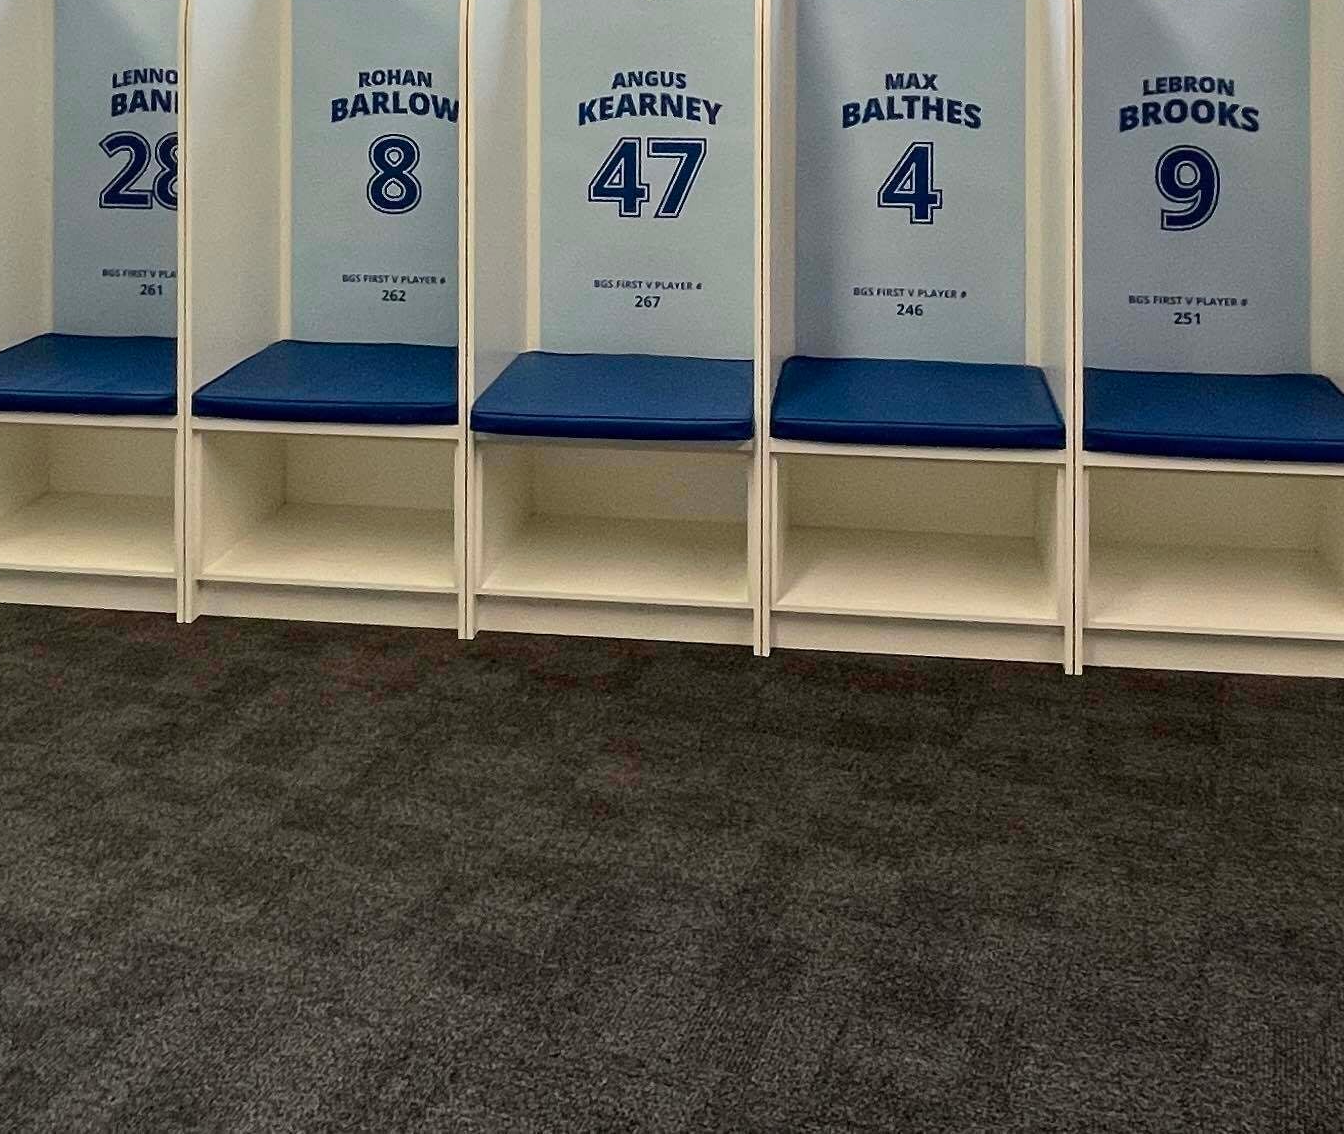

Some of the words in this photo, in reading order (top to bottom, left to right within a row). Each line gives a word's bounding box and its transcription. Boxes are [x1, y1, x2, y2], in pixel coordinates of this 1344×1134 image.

[358, 69, 432, 88] ROHAN
[611, 70, 687, 90] ANGUS
[884, 72, 938, 91] MAX
[1142, 76, 1235, 97] LEBRON
[111, 89, 178, 117] BAN
[331, 91, 459, 123] BARLOW
[578, 93, 723, 126] KEARNEY
[842, 95, 982, 129] BALTHES
[1119, 98, 1259, 133] BROOKS
[98, 131, 178, 211] 28
[366, 133, 422, 215] 8
[588, 136, 707, 218] 47
[877, 141, 943, 225] 4
[1155, 144, 1221, 232] 9
[102, 269, 120, 277] BGS
[122, 269, 147, 278] FIRST
[150, 270, 157, 278] V
[342, 274, 360, 282] BGS
[363, 274, 390, 283] FIRST
[392, 275, 399, 283] V
[401, 275, 437, 284] PLAYER
[140, 284, 162, 295] 261
[594, 279, 613, 288] BGS
[616, 280, 642, 289] FIRST
[646, 281, 653, 289] V
[655, 281, 692, 290] PLAYER
[853, 287, 874, 296] BGS
[876, 288, 904, 297] FIRST
[908, 288, 915, 297] V
[918, 289, 957, 298] PLAYER
[382, 290, 406, 301] 262
[634, 295, 661, 308] 267
[1129, 295, 1150, 304] BGS
[1153, 296, 1182, 305] FIRST
[1185, 297, 1193, 305] V
[1196, 297, 1237, 306] PLAYER
[896, 303, 923, 316] 246
[1174, 312, 1201, 325] 251
